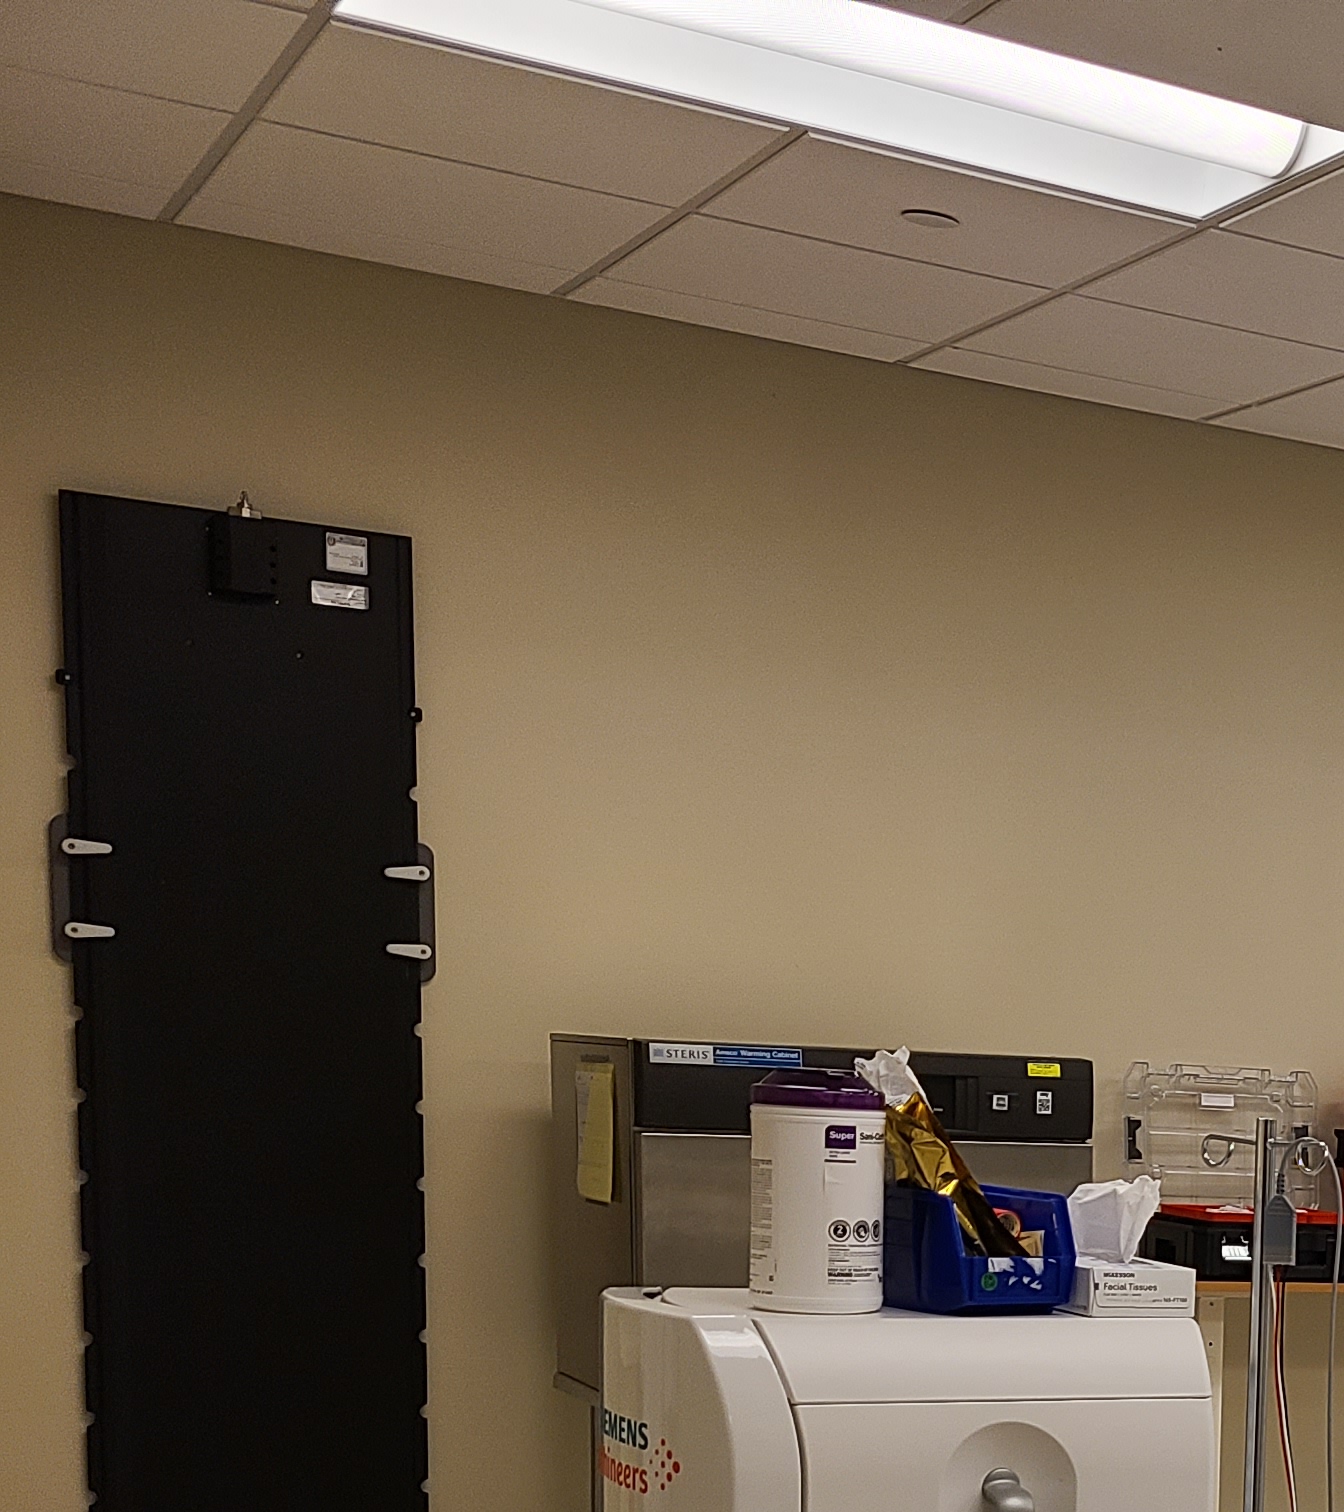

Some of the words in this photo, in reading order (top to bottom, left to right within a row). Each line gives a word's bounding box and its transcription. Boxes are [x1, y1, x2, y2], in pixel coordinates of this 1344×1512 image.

[666, 1049, 709, 1060] STERIS
[740, 1050, 771, 1059] Warming
[772, 1051, 799, 1059] Cabinet
[829, 1131, 855, 1141] Super
[1103, 1282, 1127, 1291] Facial
[1128, 1283, 1158, 1292] Tissues
[603, 1408, 649, 1451] EMENS
